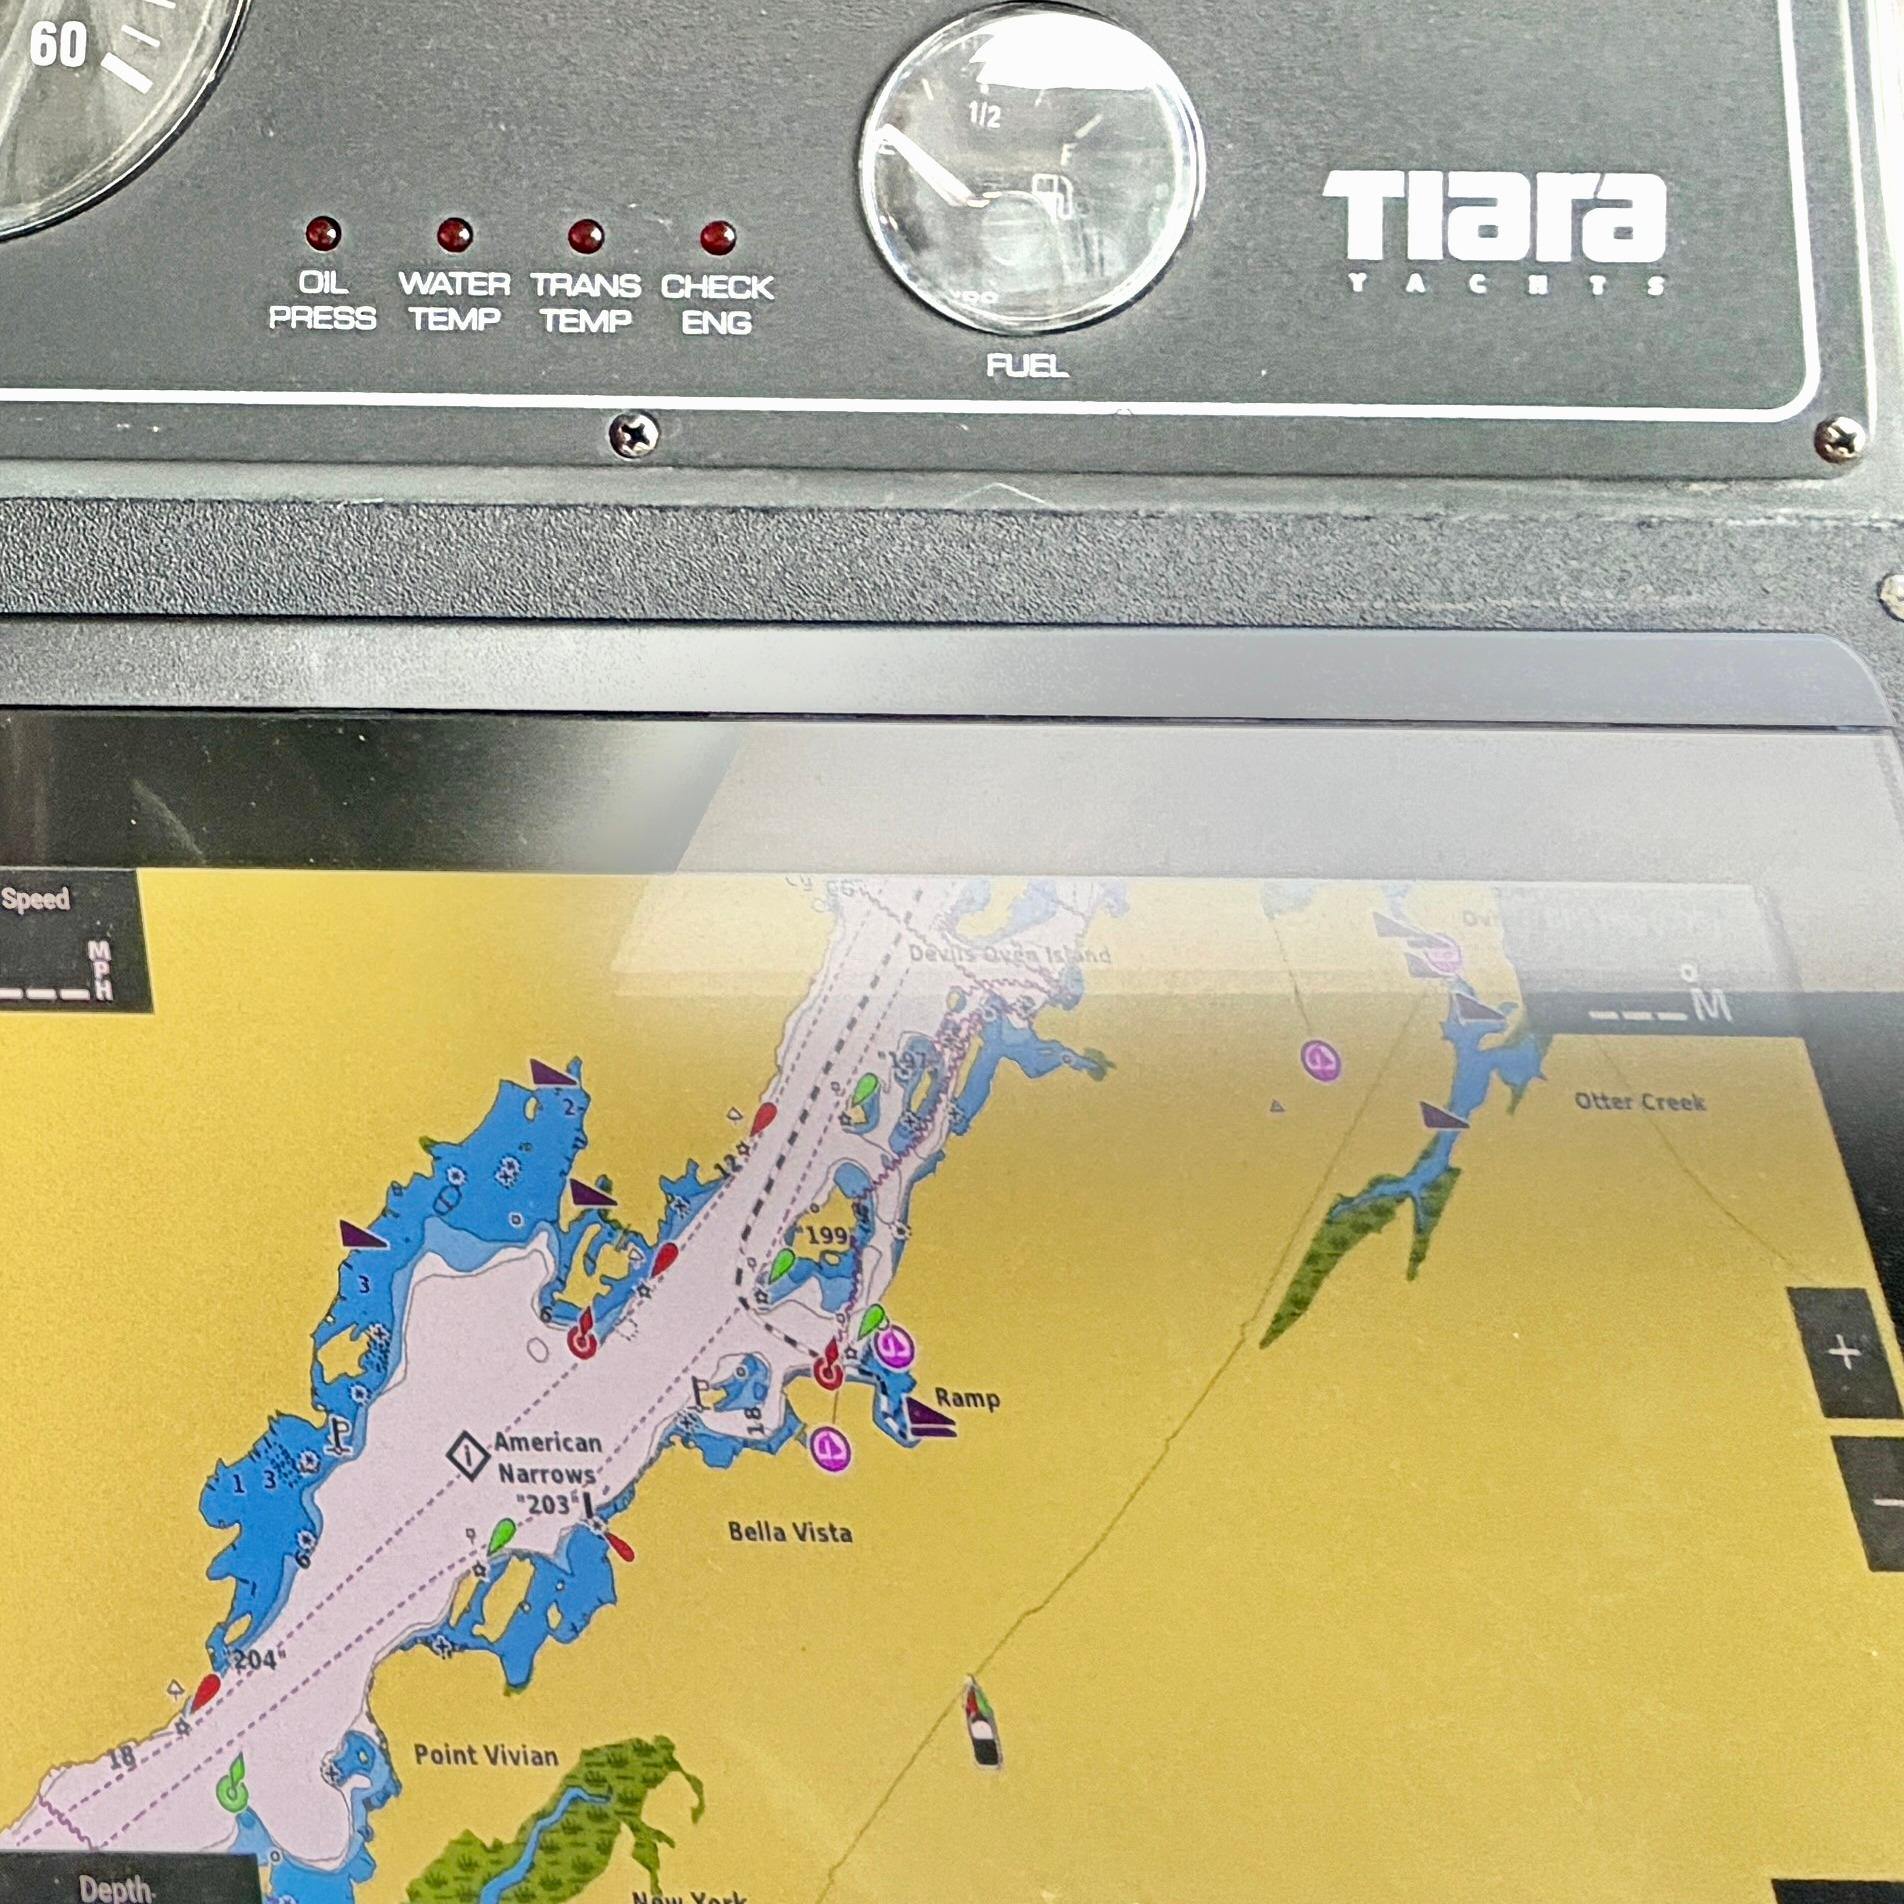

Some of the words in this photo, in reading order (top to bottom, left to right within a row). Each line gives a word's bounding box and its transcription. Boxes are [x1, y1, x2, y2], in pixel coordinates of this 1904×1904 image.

[29, 21, 87, 67] 60
[969, 100, 1001, 129] 1/2
[1060, 142, 1077, 166] F
[299, 269, 349, 295] OIL
[399, 271, 511, 297] WATER
[531, 272, 642, 297] TRANS
[661, 274, 775, 300] CHECK
[1349, 272, 1665, 296] YACHTS
[269, 305, 377, 331] PRESS
[408, 306, 502, 332] TEMP
[540, 308, 632, 334] TEMP
[682, 309, 753, 336] ENG
[986, 352, 1071, 379] FUEL
[1, 887, 70, 913] Speed
[88, 940, 113, 1001] MPH
[1576, 1092, 1633, 1110] Otter
[1641, 1093, 1707, 1112] Creek
[358, 1277, 370, 1293] 3
[936, 1387, 1000, 1413] Ramp
[495, 1432, 603, 1453] American
[233, 1474, 245, 1494] 1
[264, 1470, 276, 1489] 3
[499, 1463, 596, 1485] Narrows
[728, 1521, 785, 1542] Bella
[792, 1522, 853, 1543] Vista
[108, 1746, 136, 1770] 18
[413, 1744, 481, 1766] Point
[488, 1745, 559, 1767] Vivian
[79, 1874, 149, 1903] Depth
